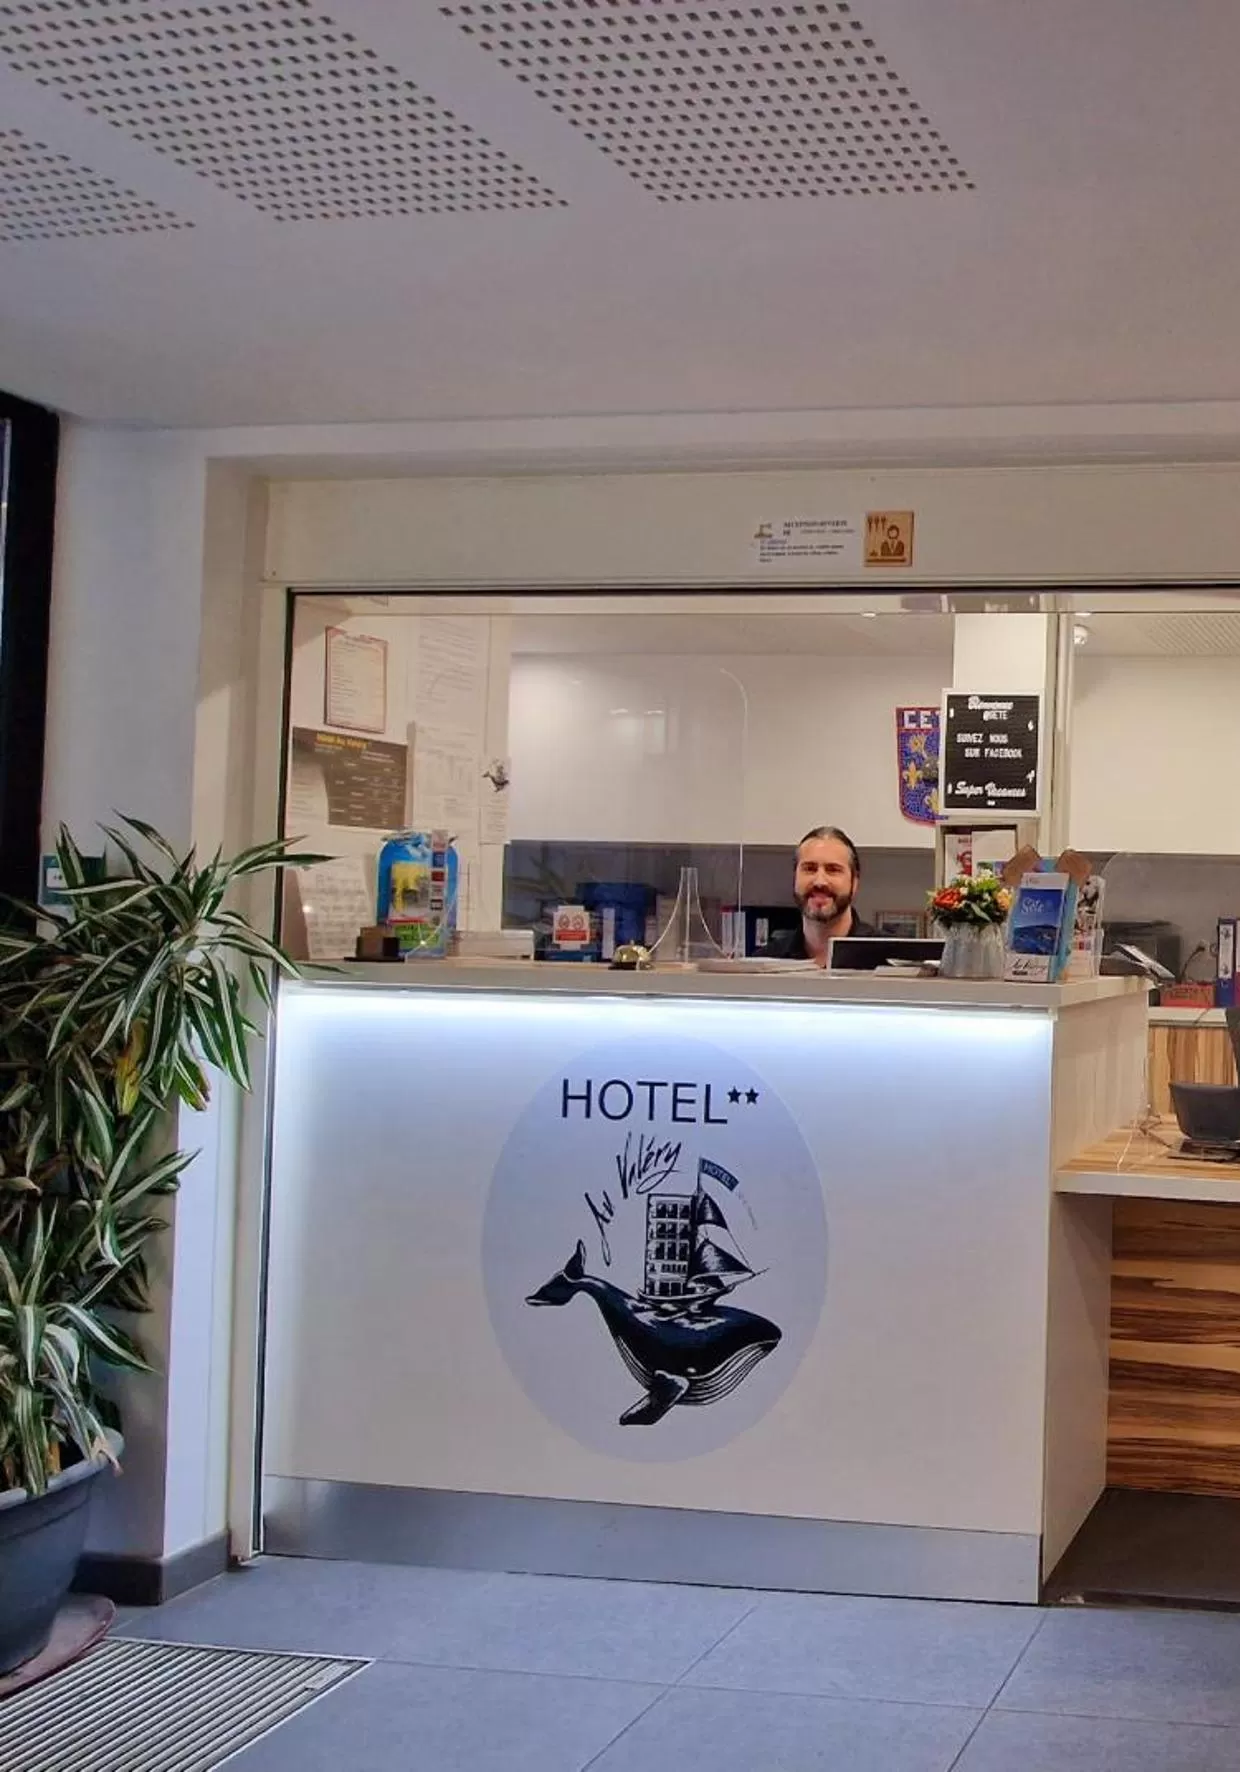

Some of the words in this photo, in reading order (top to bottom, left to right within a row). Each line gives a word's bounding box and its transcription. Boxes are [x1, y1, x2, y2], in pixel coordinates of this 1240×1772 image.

[984, 748, 1022, 758] FACEBOOK
[560, 1078, 728, 1125] HOTEL
[616, 1131, 684, 1200] Valéry
[703, 1161, 735, 1188] HOTEL
